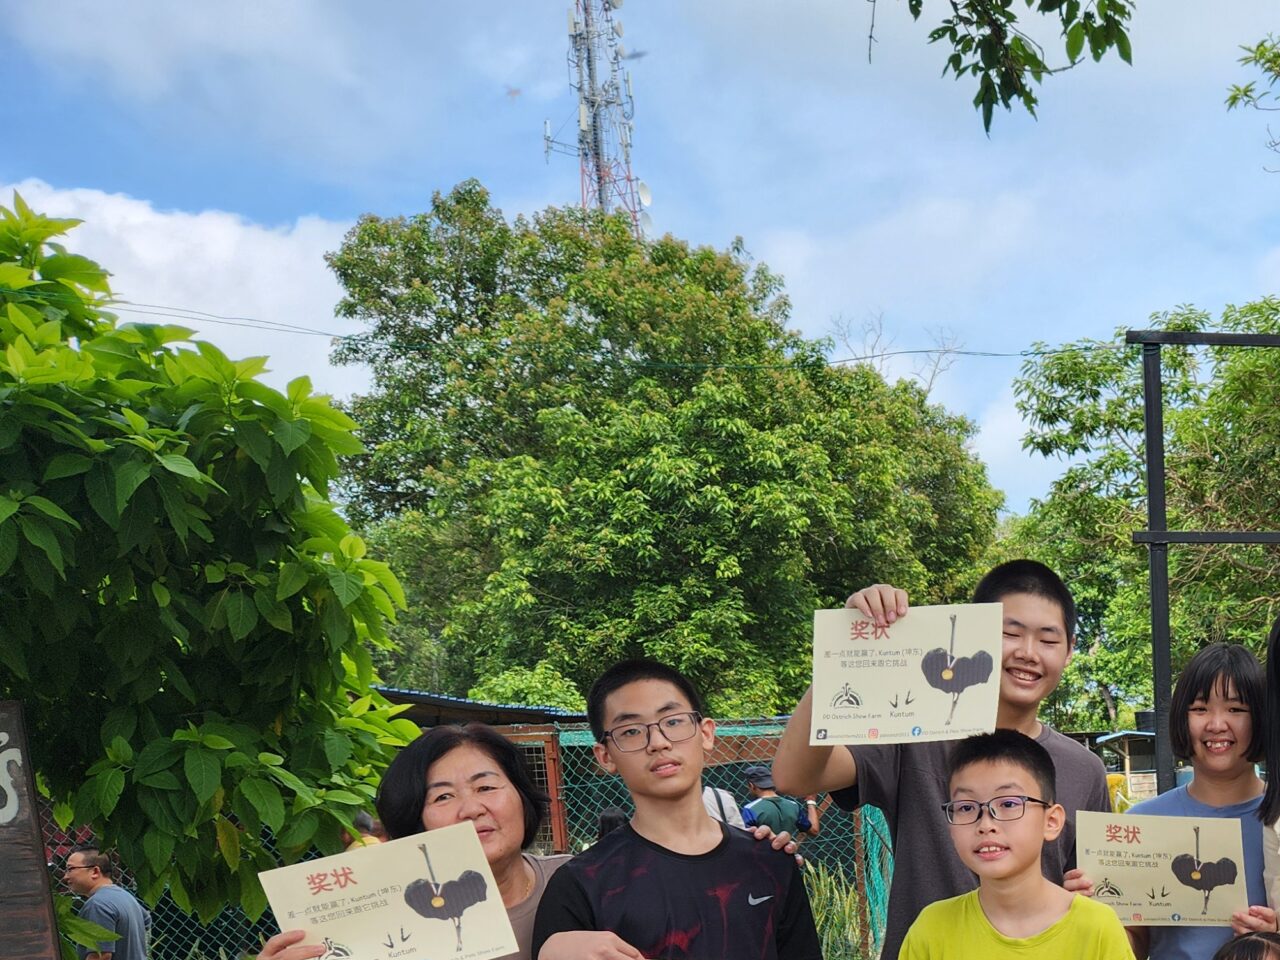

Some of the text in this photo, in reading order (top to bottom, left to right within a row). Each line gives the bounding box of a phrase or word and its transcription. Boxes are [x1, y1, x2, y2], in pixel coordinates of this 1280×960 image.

[850, 620, 890, 640] 奖状
[1105, 824, 1141, 843] 奖状
[306, 866, 358, 896] 奖状
[388, 946, 417, 958] Kuntum
